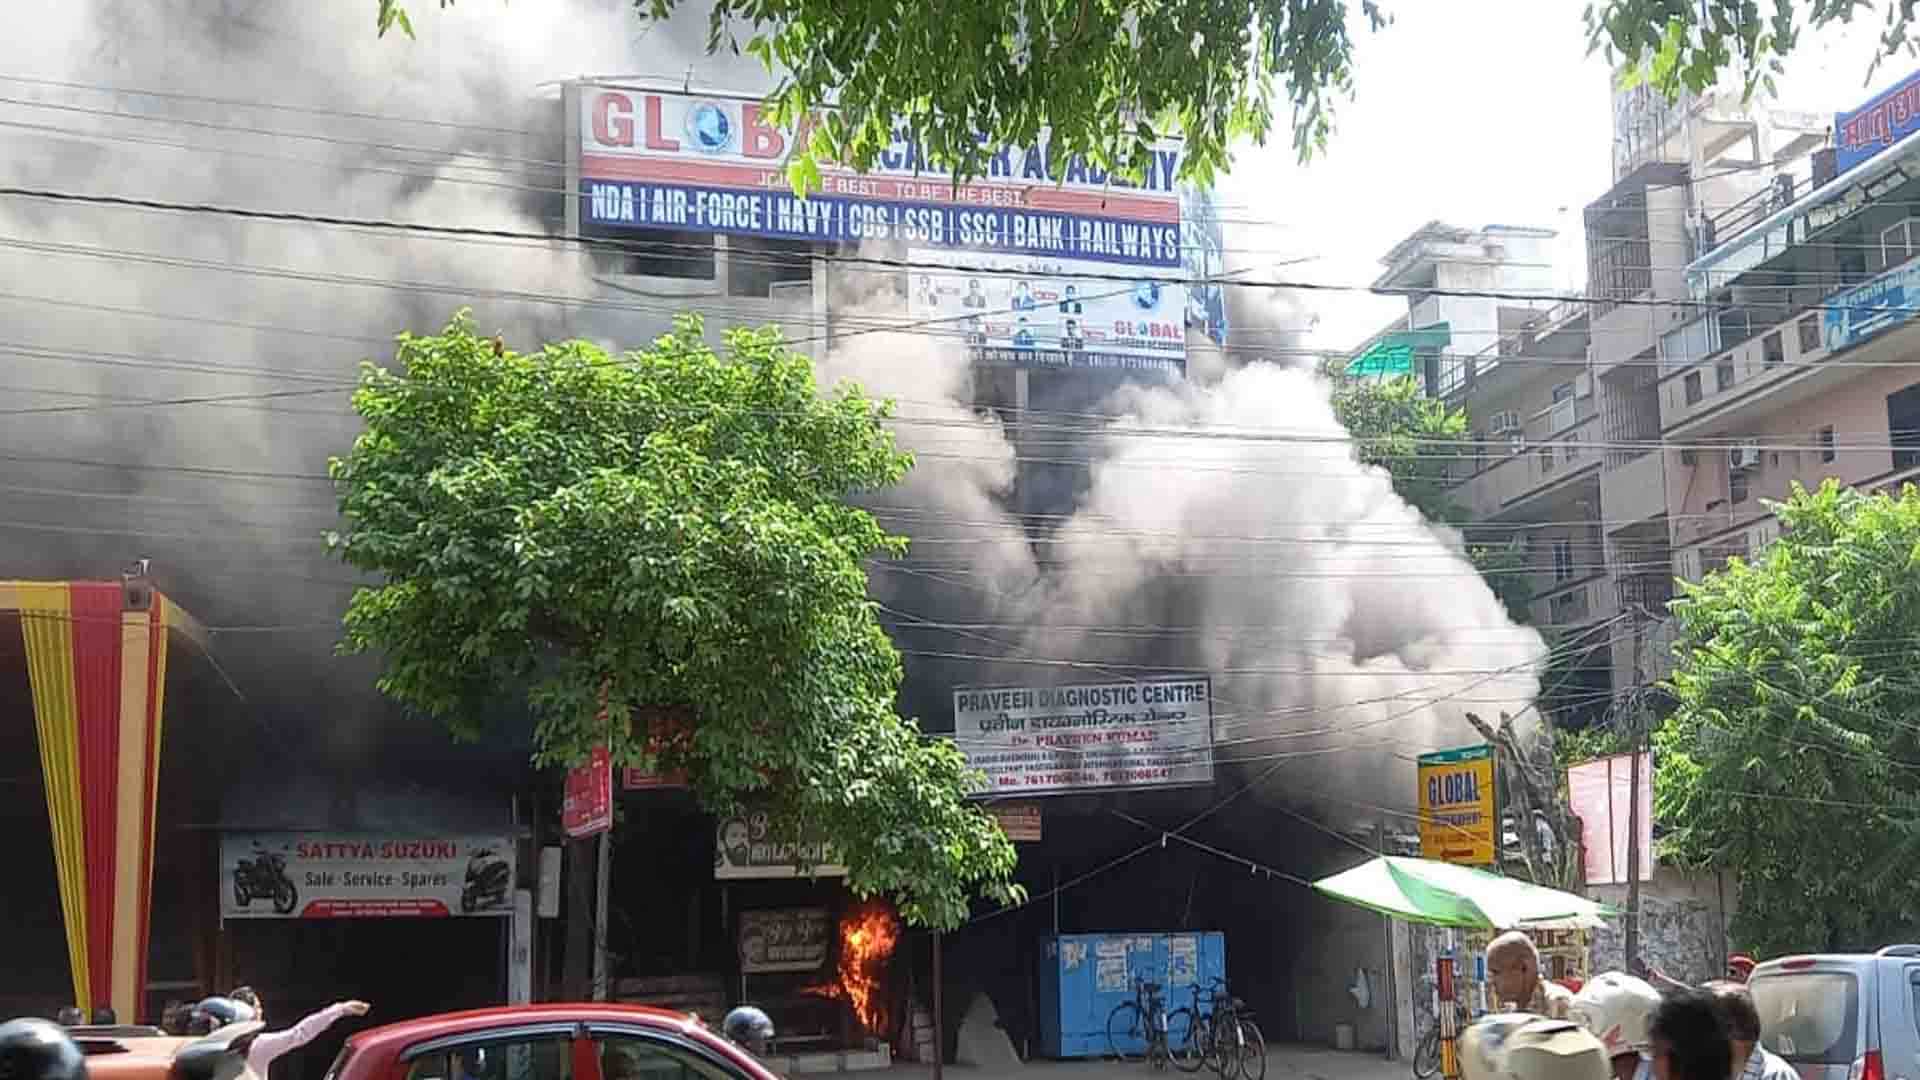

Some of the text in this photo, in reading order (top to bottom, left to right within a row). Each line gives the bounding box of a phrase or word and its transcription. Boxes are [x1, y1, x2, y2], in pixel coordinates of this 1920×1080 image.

[895, 183, 916, 198] TO
[920, 185, 943, 200] BE
[592, 184, 1178, 260] NDA AIR-FORCE NAVY CDS SSB SSC BANK RAILWAYS
[1039, 686, 1138, 708] DIAGNOSTIC
[1142, 684, 1206, 705] CENTRE
[1427, 769, 1481, 806] GLOBAL
[296, 841, 457, 860] SATTYA SUZUKI
[304, 871, 448, 892] Sale Service Spares
